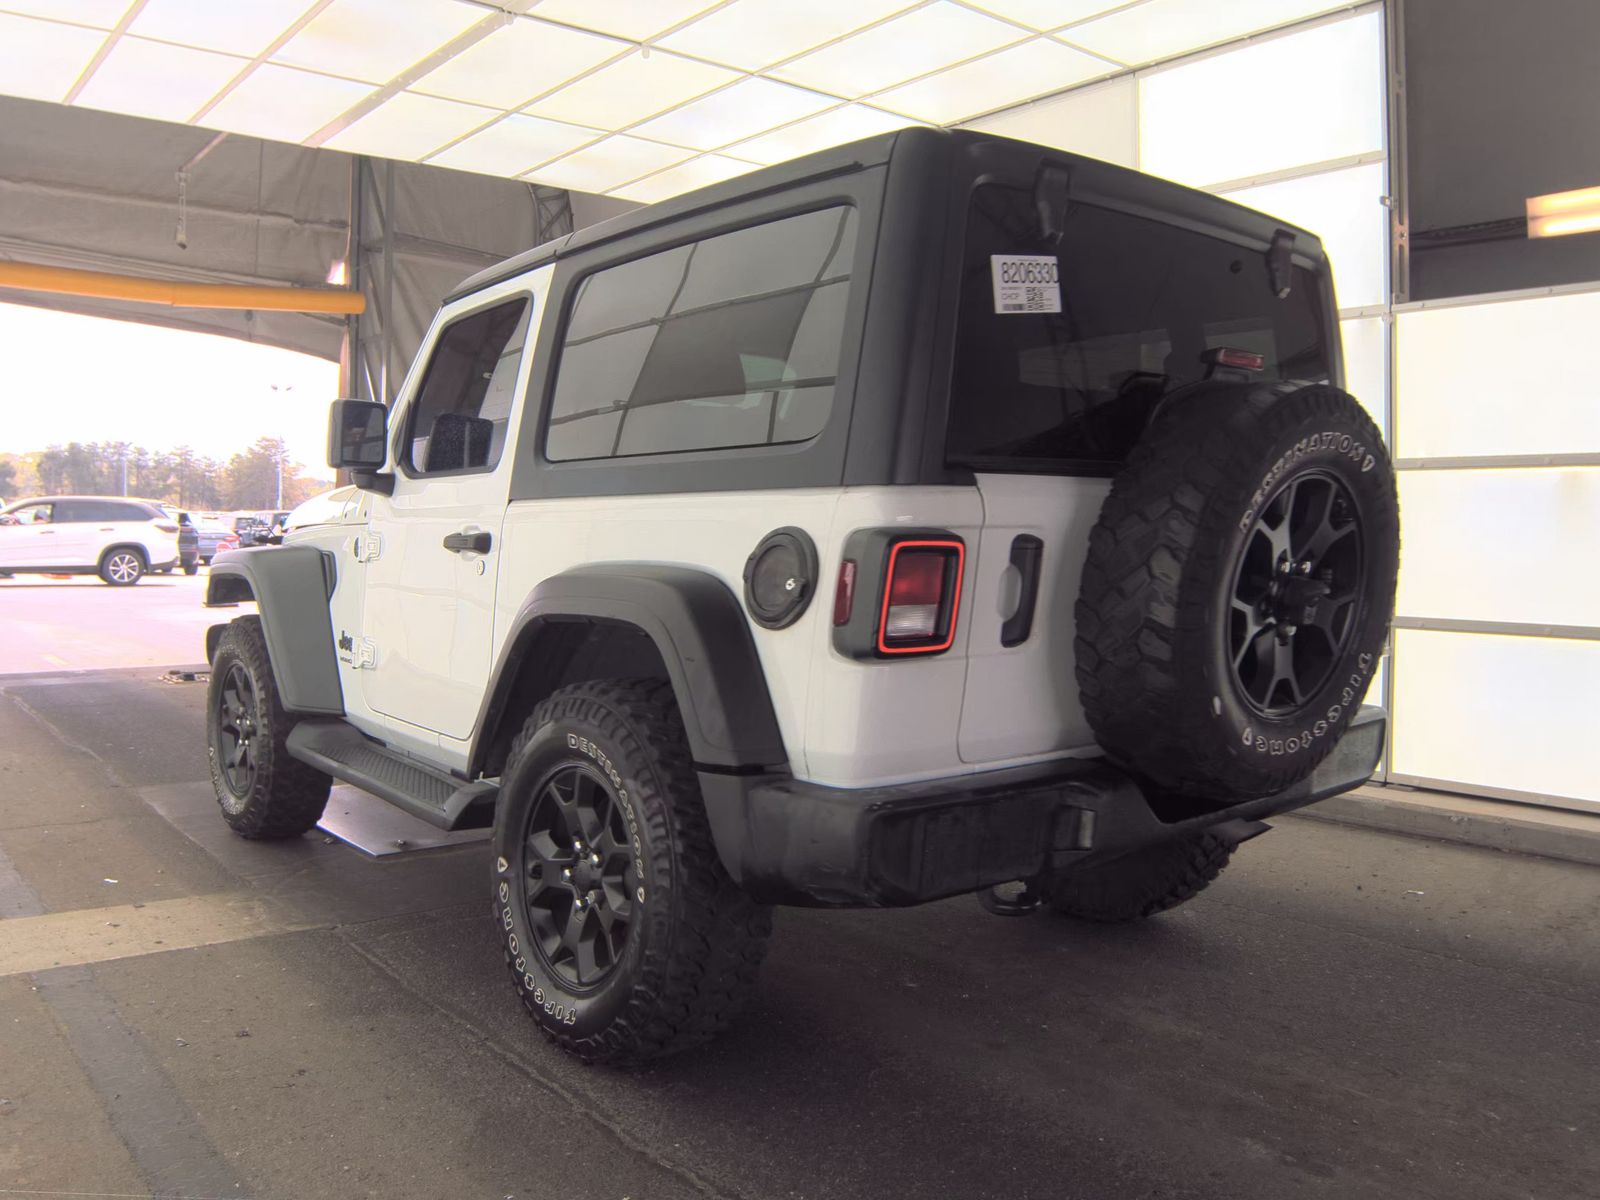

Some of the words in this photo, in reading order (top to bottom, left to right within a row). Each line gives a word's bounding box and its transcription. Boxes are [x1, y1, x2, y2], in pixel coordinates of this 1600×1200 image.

[1001, 262, 1060, 284] 8206330
[1239, 432, 1365, 533] DESTINATION
[567, 733, 644, 879] DESTINATION
